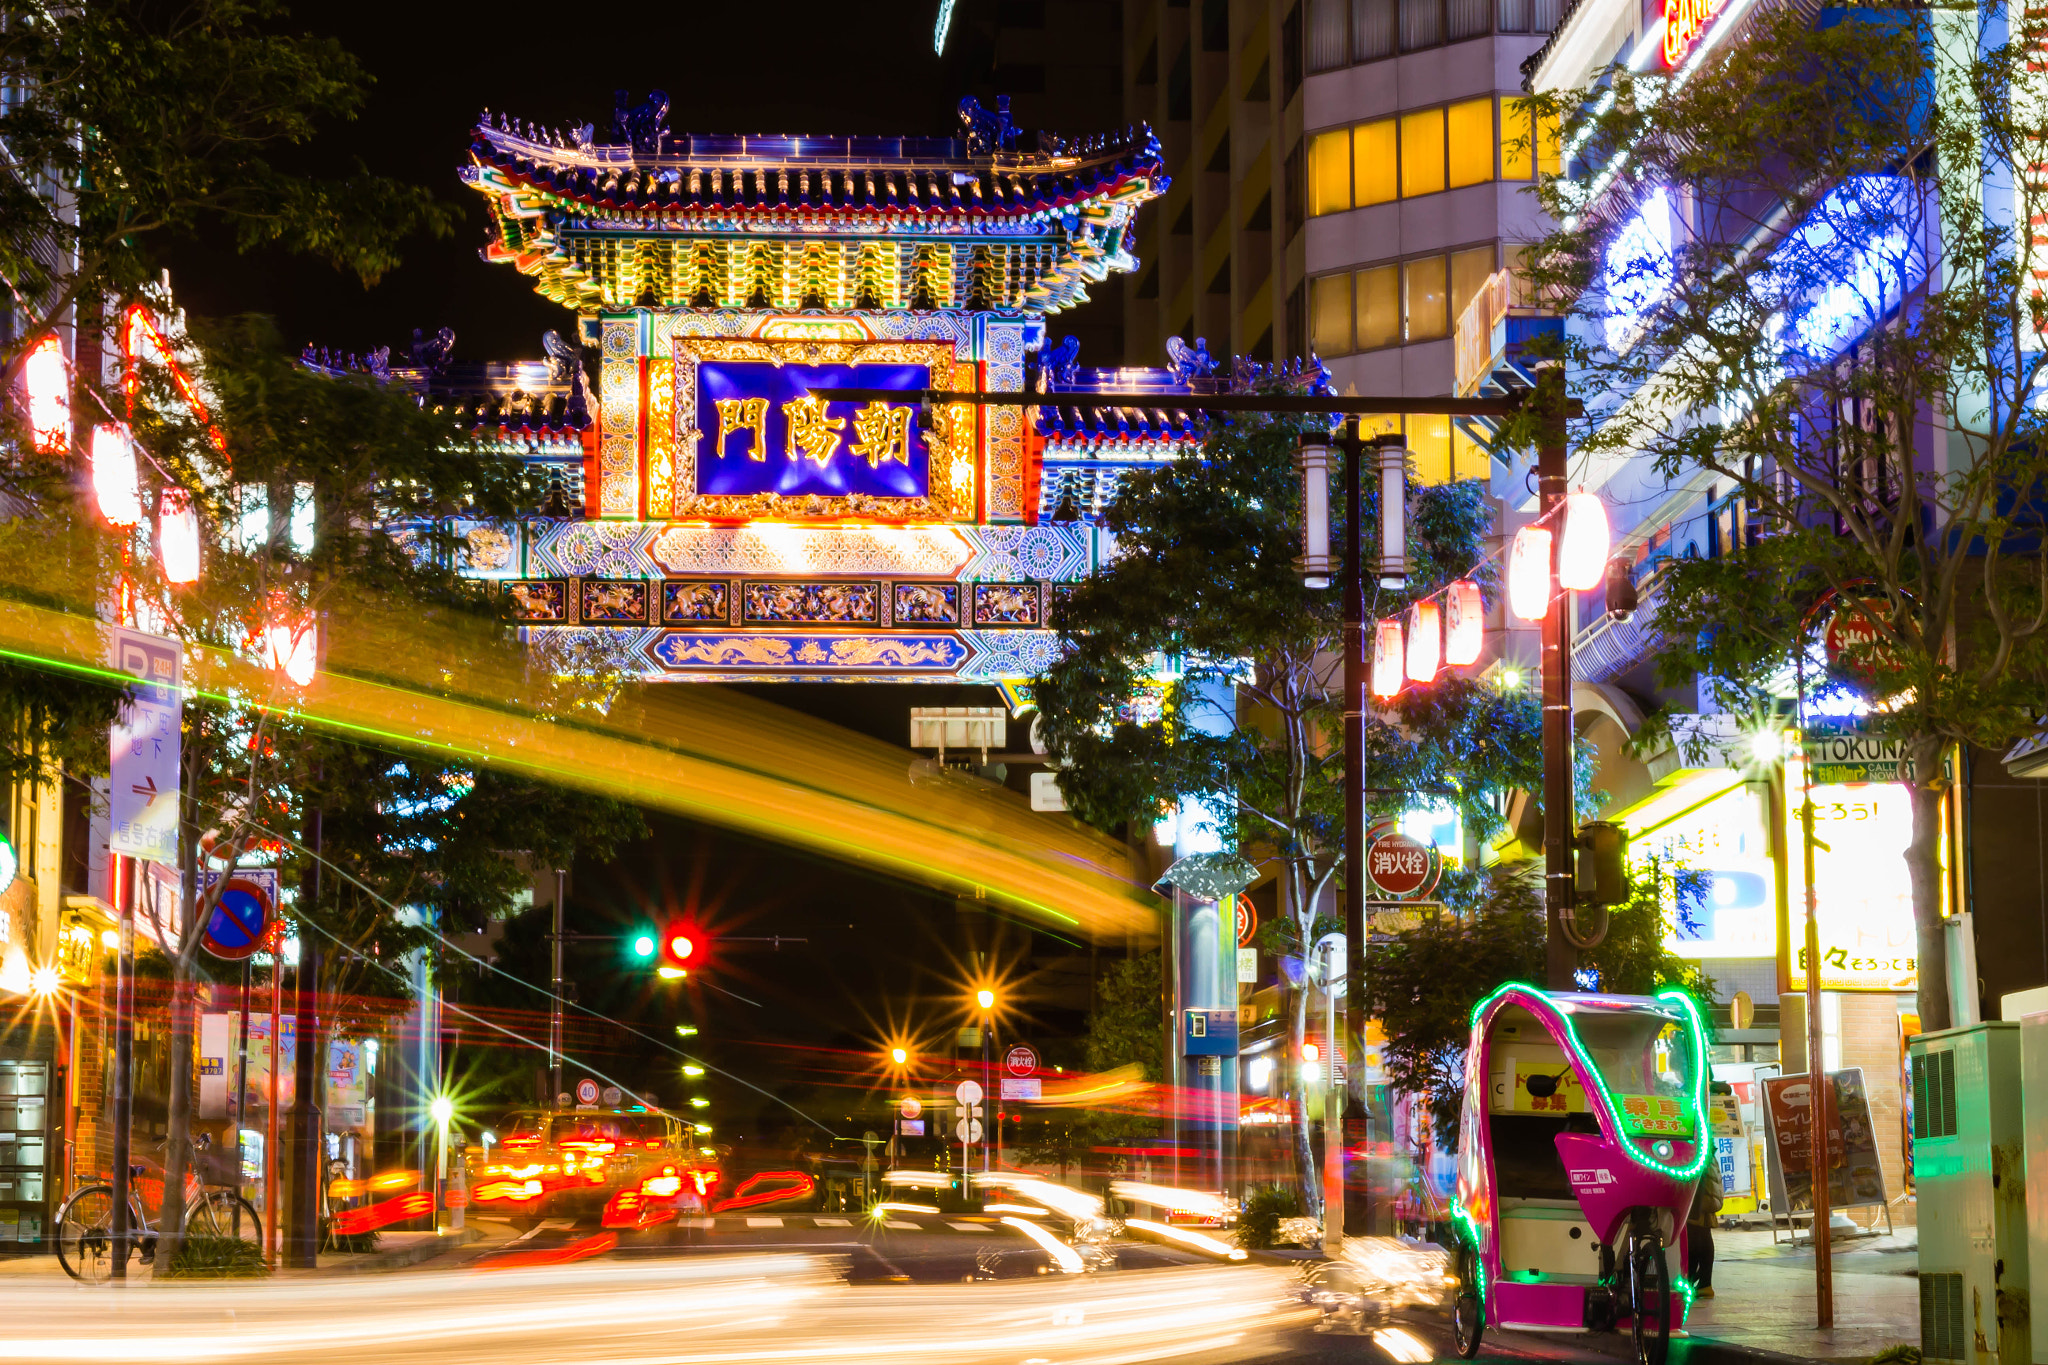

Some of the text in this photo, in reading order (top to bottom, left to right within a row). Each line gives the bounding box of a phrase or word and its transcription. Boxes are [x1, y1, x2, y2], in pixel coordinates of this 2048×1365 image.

[154, 658, 172, 677] 24H
[1868, 763, 1895, 772] CALL
[1869, 771, 1896, 780] NOW
[1374, 851, 1424, 875] 消火栓
[1010, 1056, 1033, 1068] 消火栓
[582, 1086, 594, 1098] 40
[1622, 1096, 1683, 1118] 乗車
[1718, 1138, 1736, 1193] 時間貸
